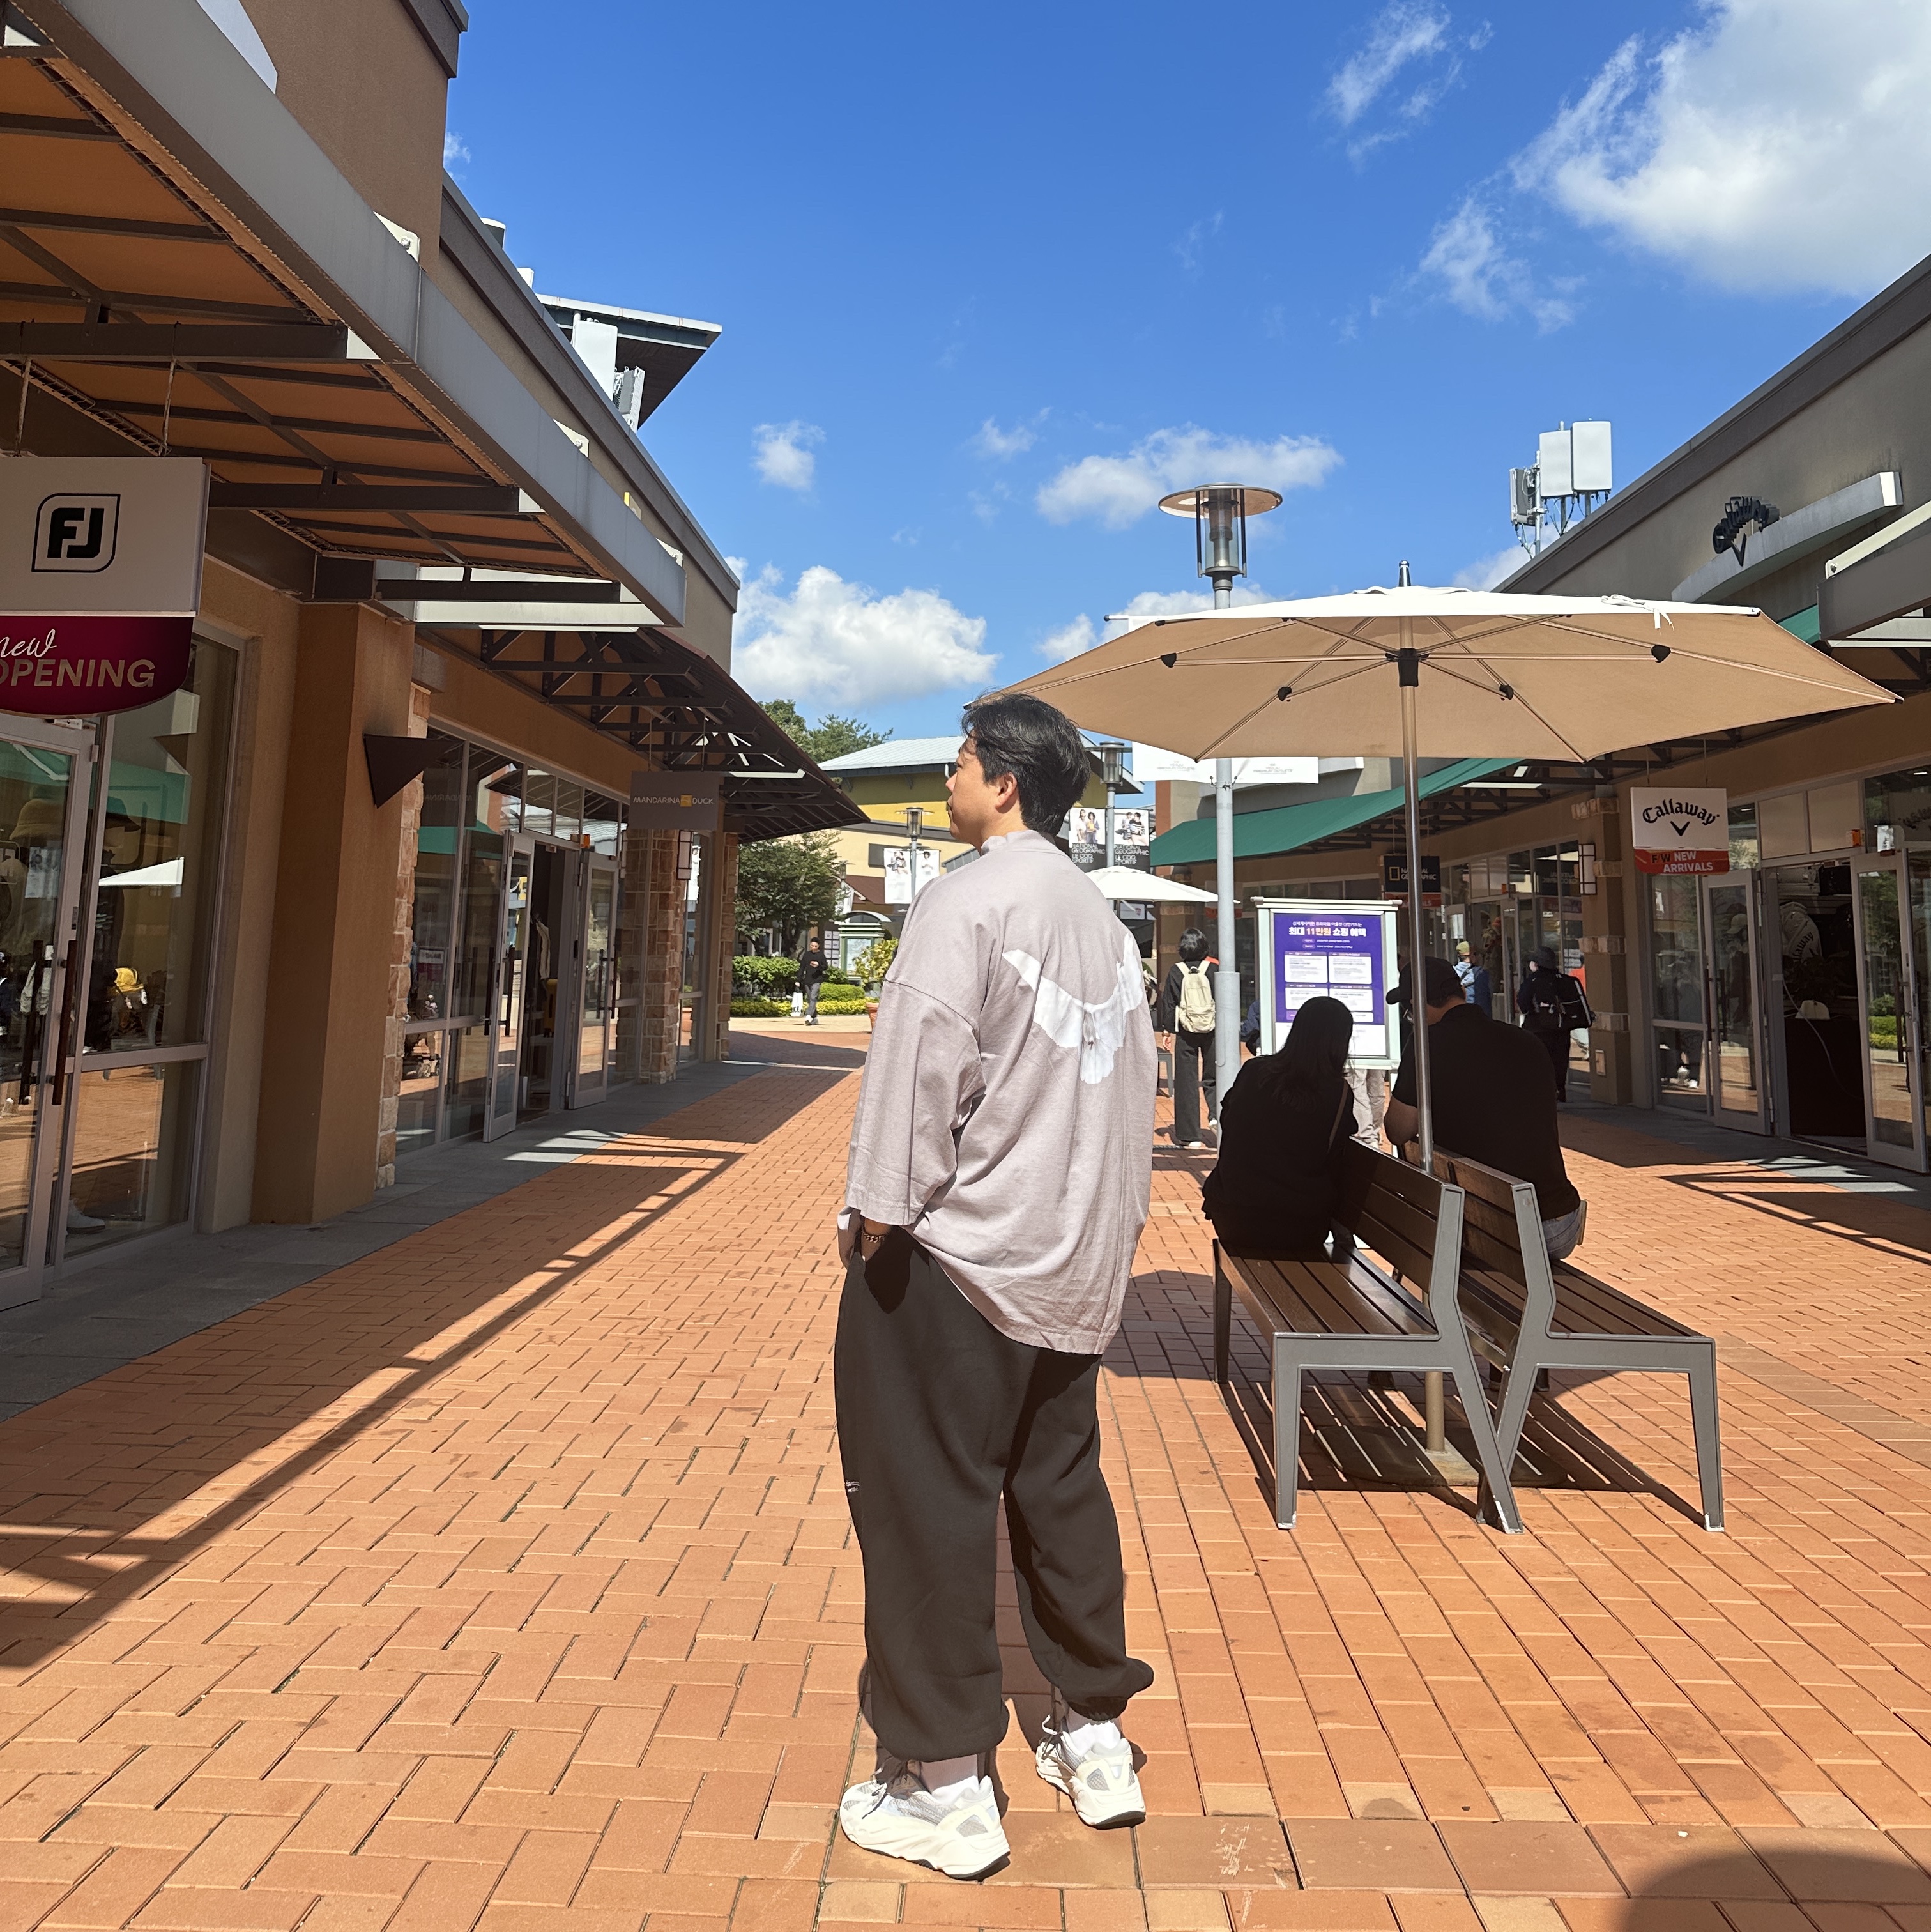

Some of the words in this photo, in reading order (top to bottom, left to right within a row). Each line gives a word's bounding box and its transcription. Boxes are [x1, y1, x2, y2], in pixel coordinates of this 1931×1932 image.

[47, 507, 105, 559] FJ
[1642, 799, 1716, 826] Callaway
[1674, 850, 1697, 861] NEW
[1663, 862, 1713, 873] ARRIVALS
[1289, 927, 1305, 935] 최대
[1306, 928, 1331, 936] 11만원
[1332, 928, 1348, 937] 쇼핑
[1350, 928, 1366, 937] 혜택
